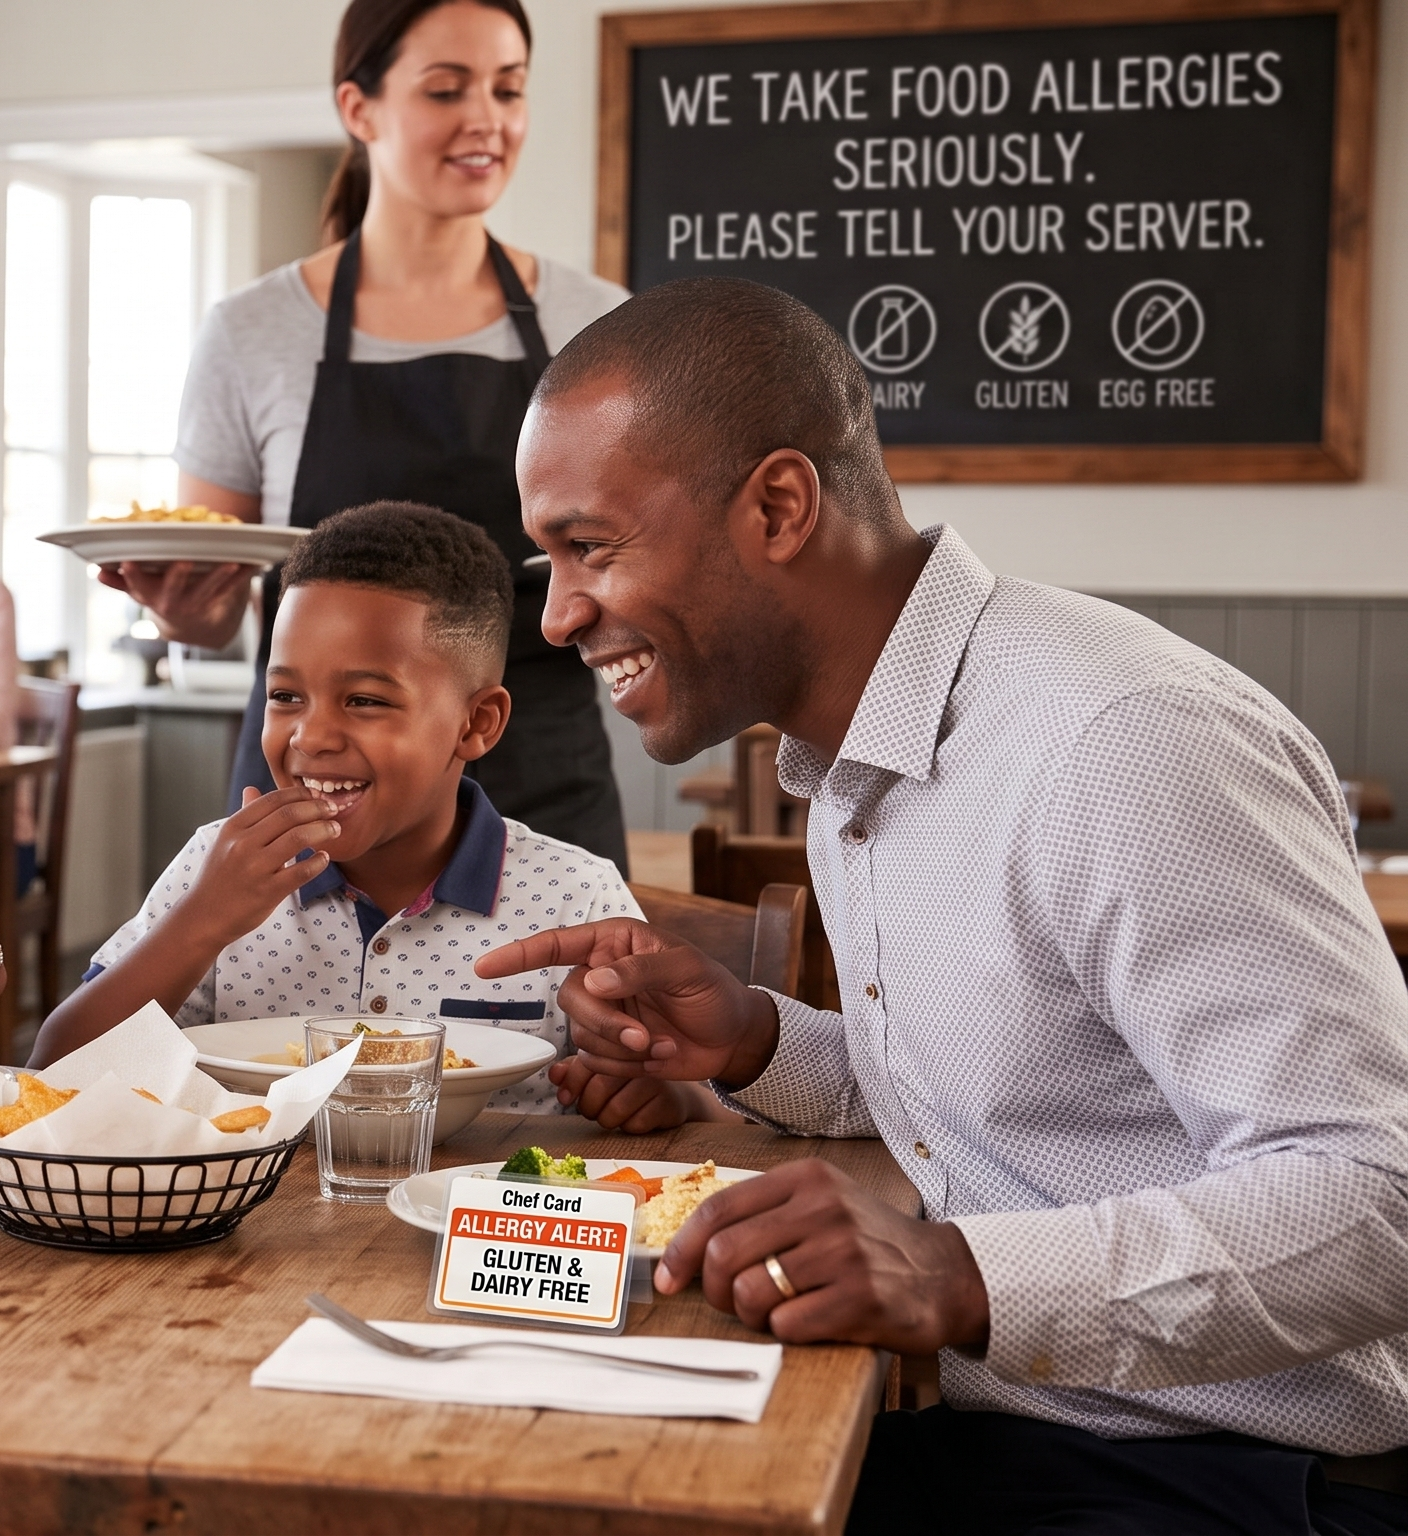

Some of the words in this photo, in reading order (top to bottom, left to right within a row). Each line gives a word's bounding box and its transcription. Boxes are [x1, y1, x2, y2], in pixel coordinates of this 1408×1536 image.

[661, 73, 731, 127] WE
[752, 69, 868, 122] TAKE
[893, 63, 1010, 119] FOOD
[1030, 51, 1283, 114] ALLERGIES
[833, 132, 1095, 191] SERIOUSLY.
[668, 212, 817, 261] PLEASE
[838, 208, 934, 257] TELL
[953, 206, 1064, 254] YOUR
[1085, 200, 1264, 251] SERVER.
[872, 381, 926, 410] AIRY
[976, 380, 1068, 408] GLUTEN
[1099, 379, 1146, 408] EGG
[1155, 378, 1215, 407] FREE
[502, 1189, 540, 1209] Chef
[543, 1194, 582, 1213] Card
[457, 1214, 547, 1240] ALLERGY
[550, 1223, 618, 1248] ALERT:
[483, 1248, 562, 1275] GLUTEN
[567, 1257, 584, 1277] &
[471, 1272, 533, 1297] DAIRY
[538, 1279, 590, 1304] FREE
